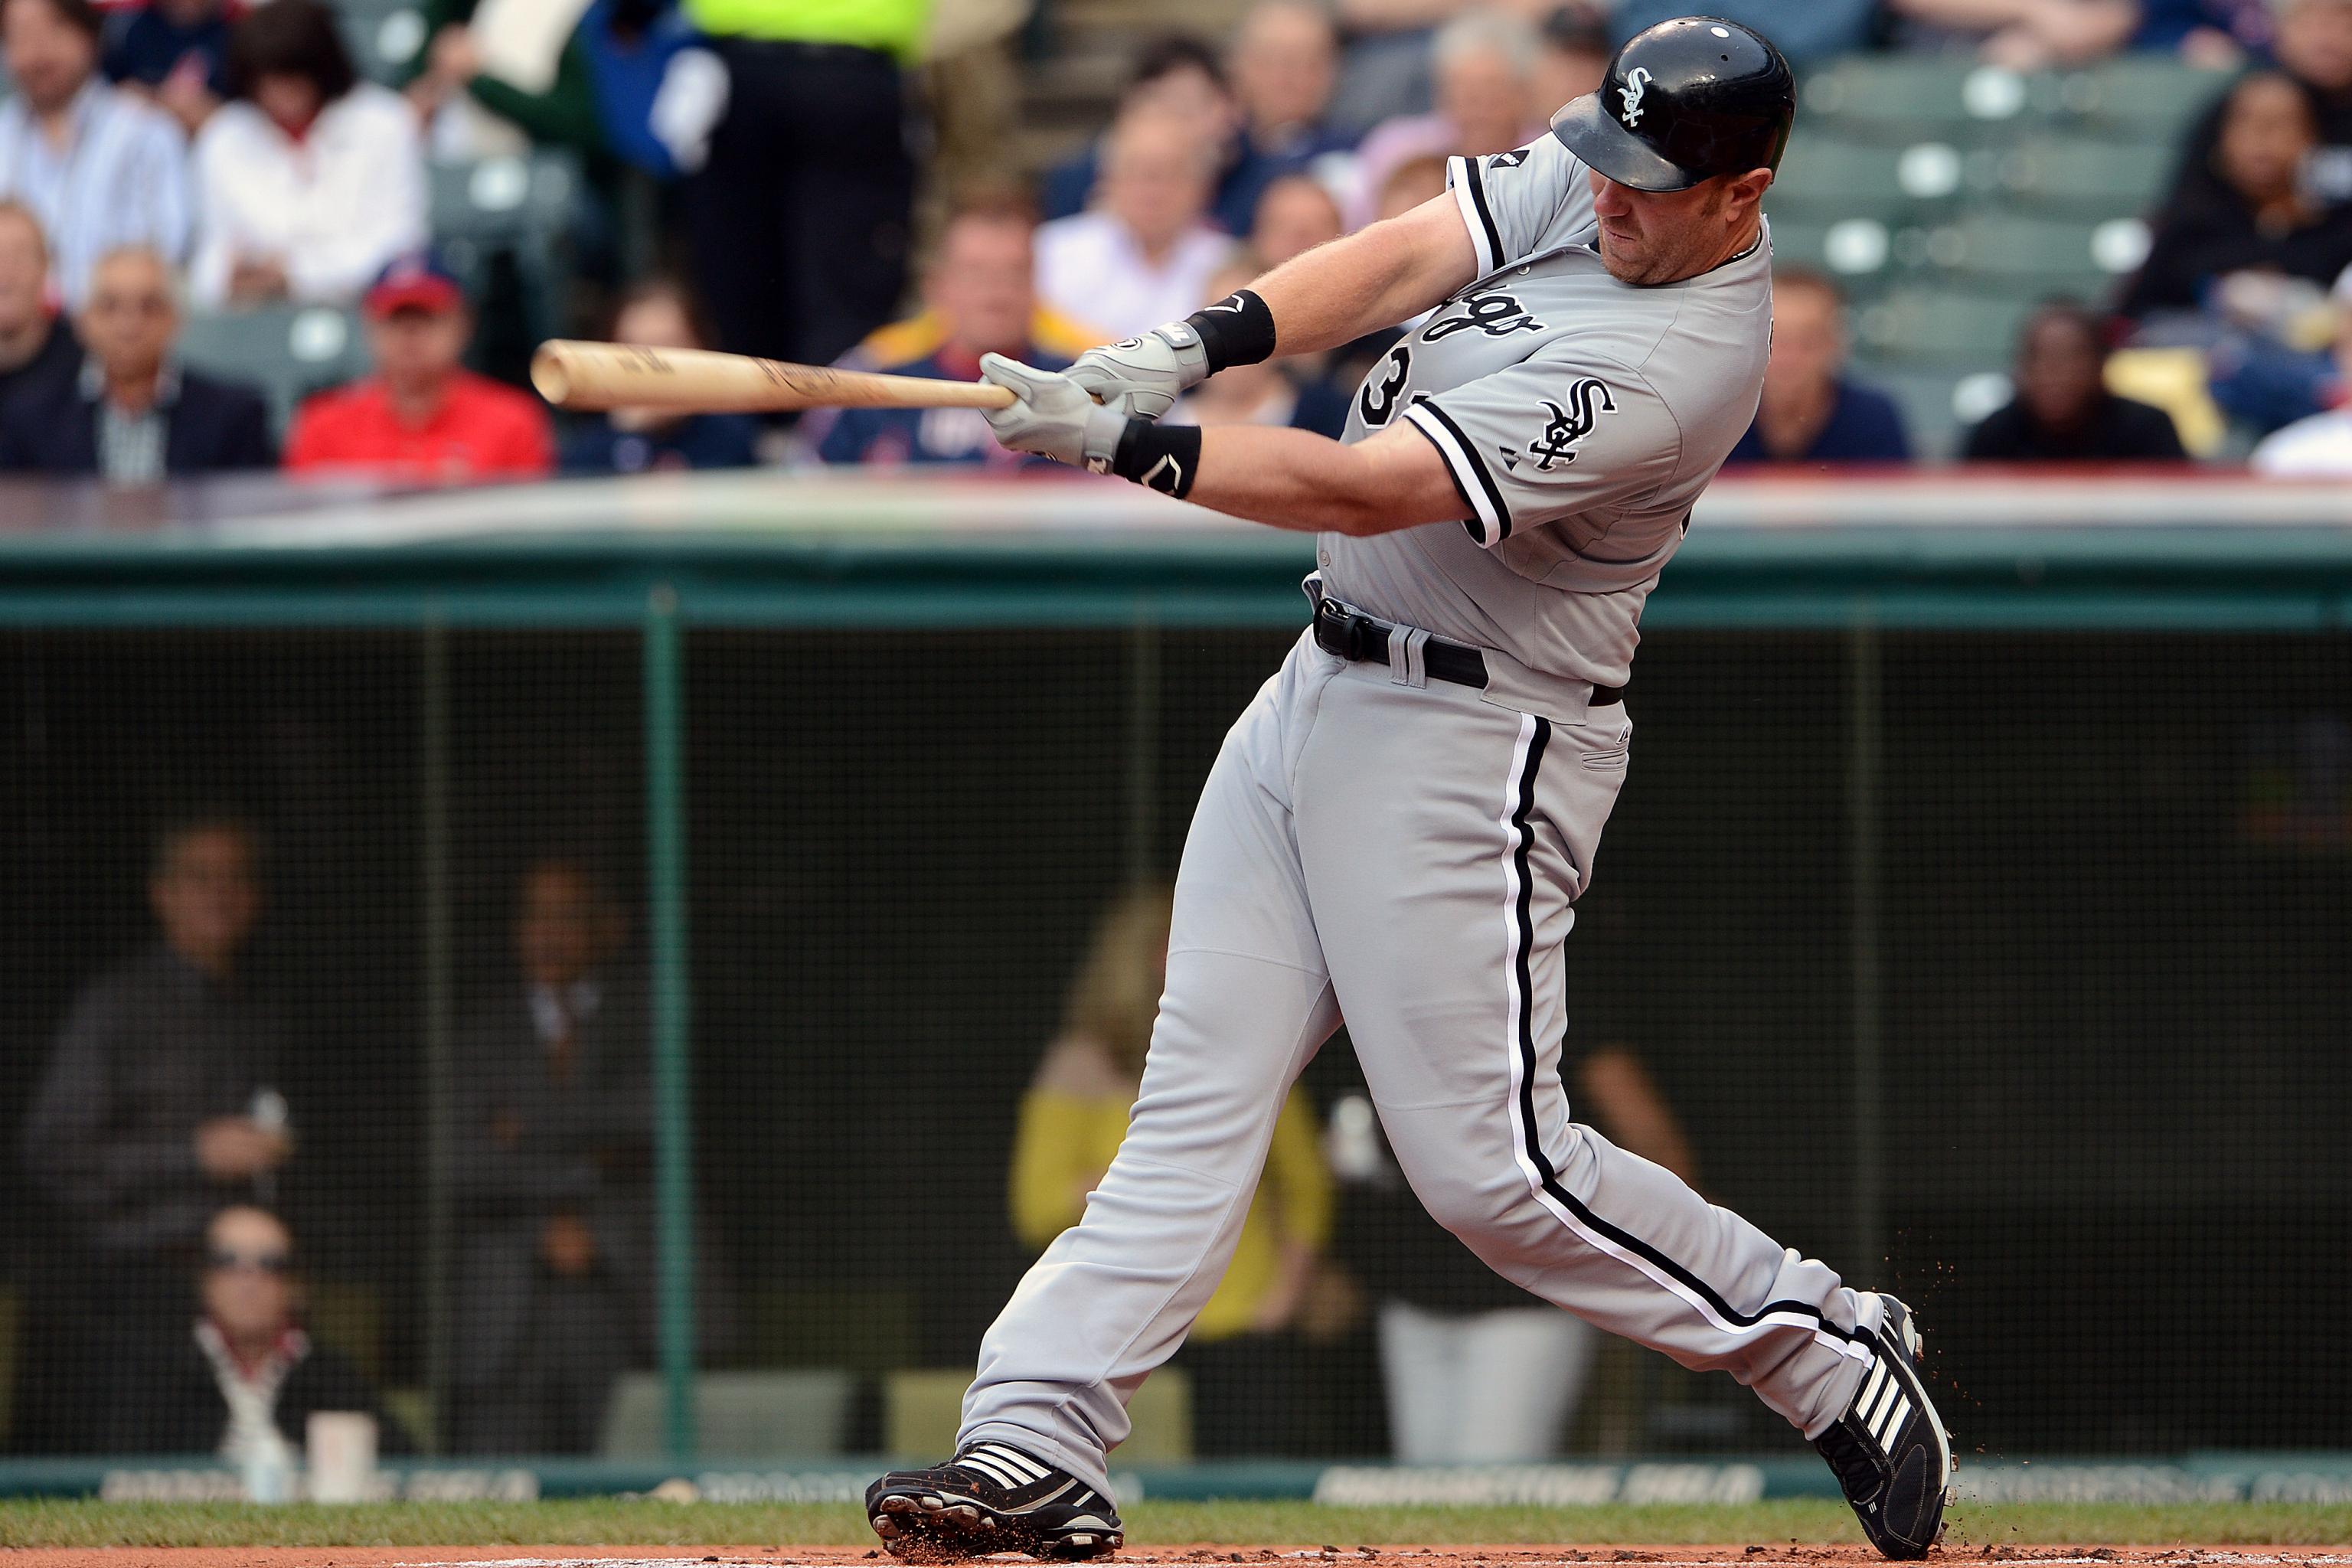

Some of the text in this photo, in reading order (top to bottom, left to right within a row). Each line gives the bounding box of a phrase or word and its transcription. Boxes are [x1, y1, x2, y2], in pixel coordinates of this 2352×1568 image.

[1617, 67, 1653, 127] Sox
[1358, 342, 1433, 429] 3
[1527, 377, 1618, 472] Sox
